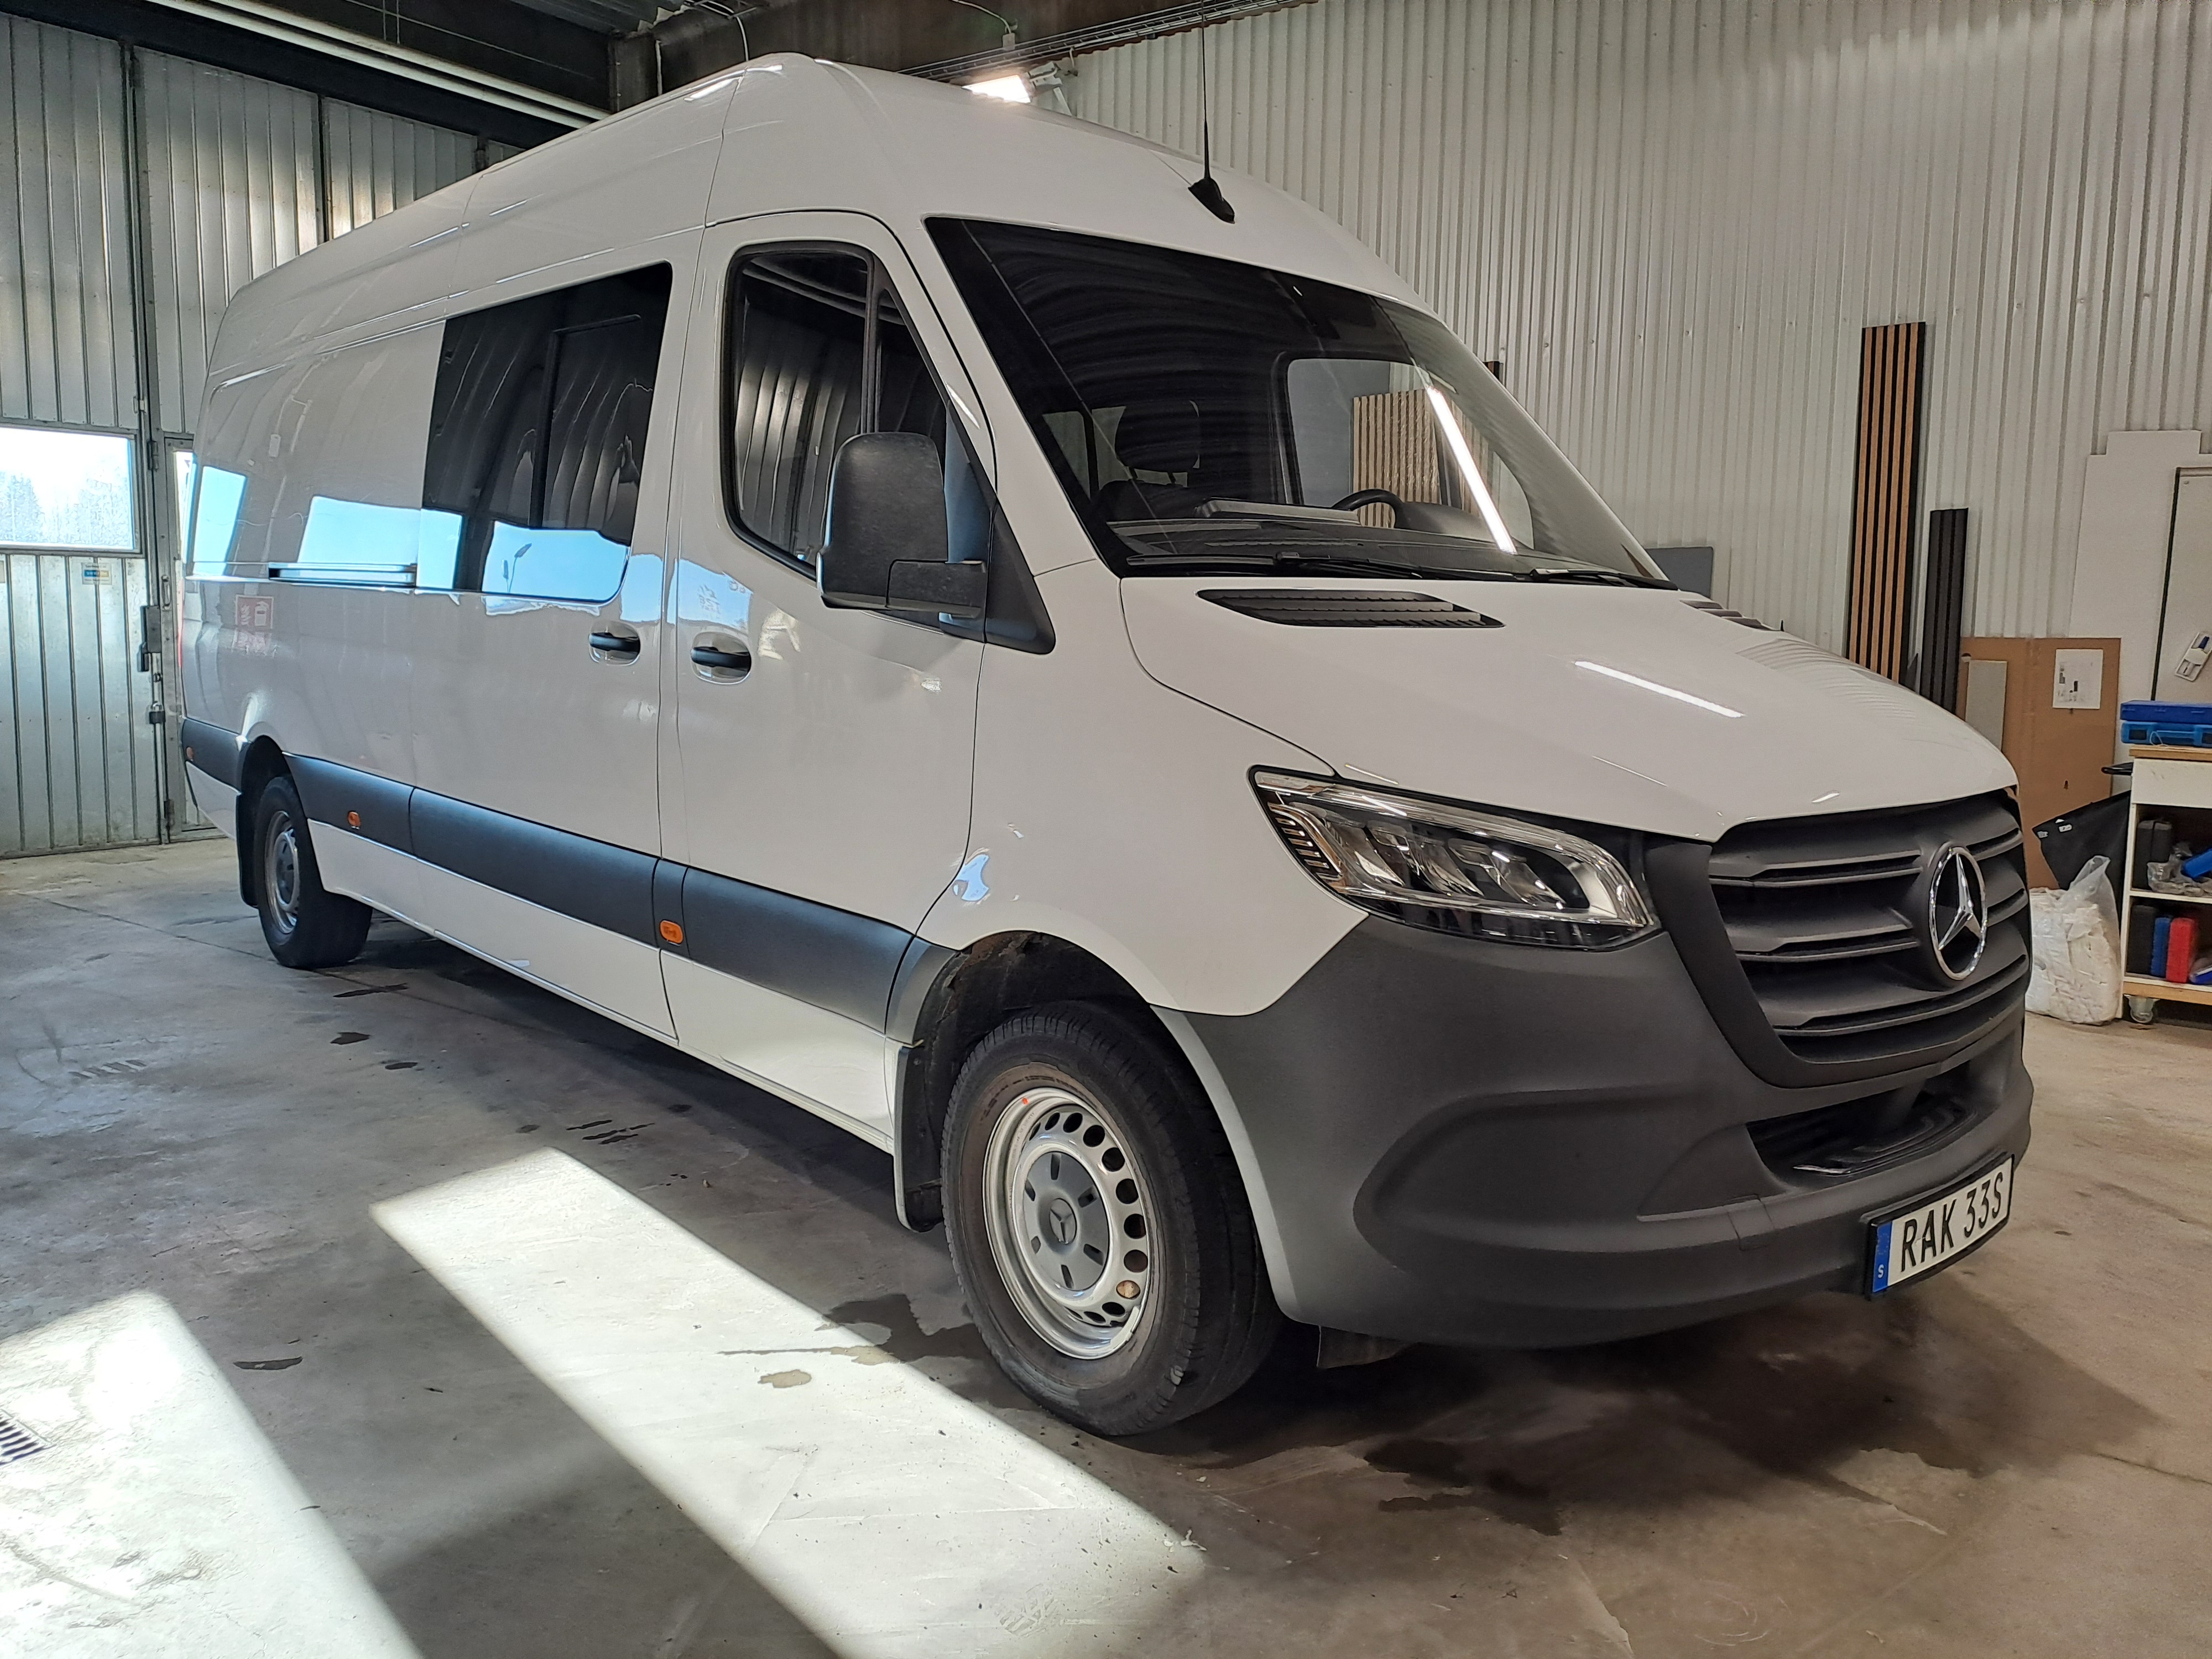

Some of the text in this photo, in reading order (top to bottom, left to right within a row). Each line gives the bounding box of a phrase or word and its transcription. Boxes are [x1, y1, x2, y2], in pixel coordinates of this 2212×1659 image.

[1901, 1172, 2003, 1272] RAK 33S
[1877, 1264, 1885, 1278] S
